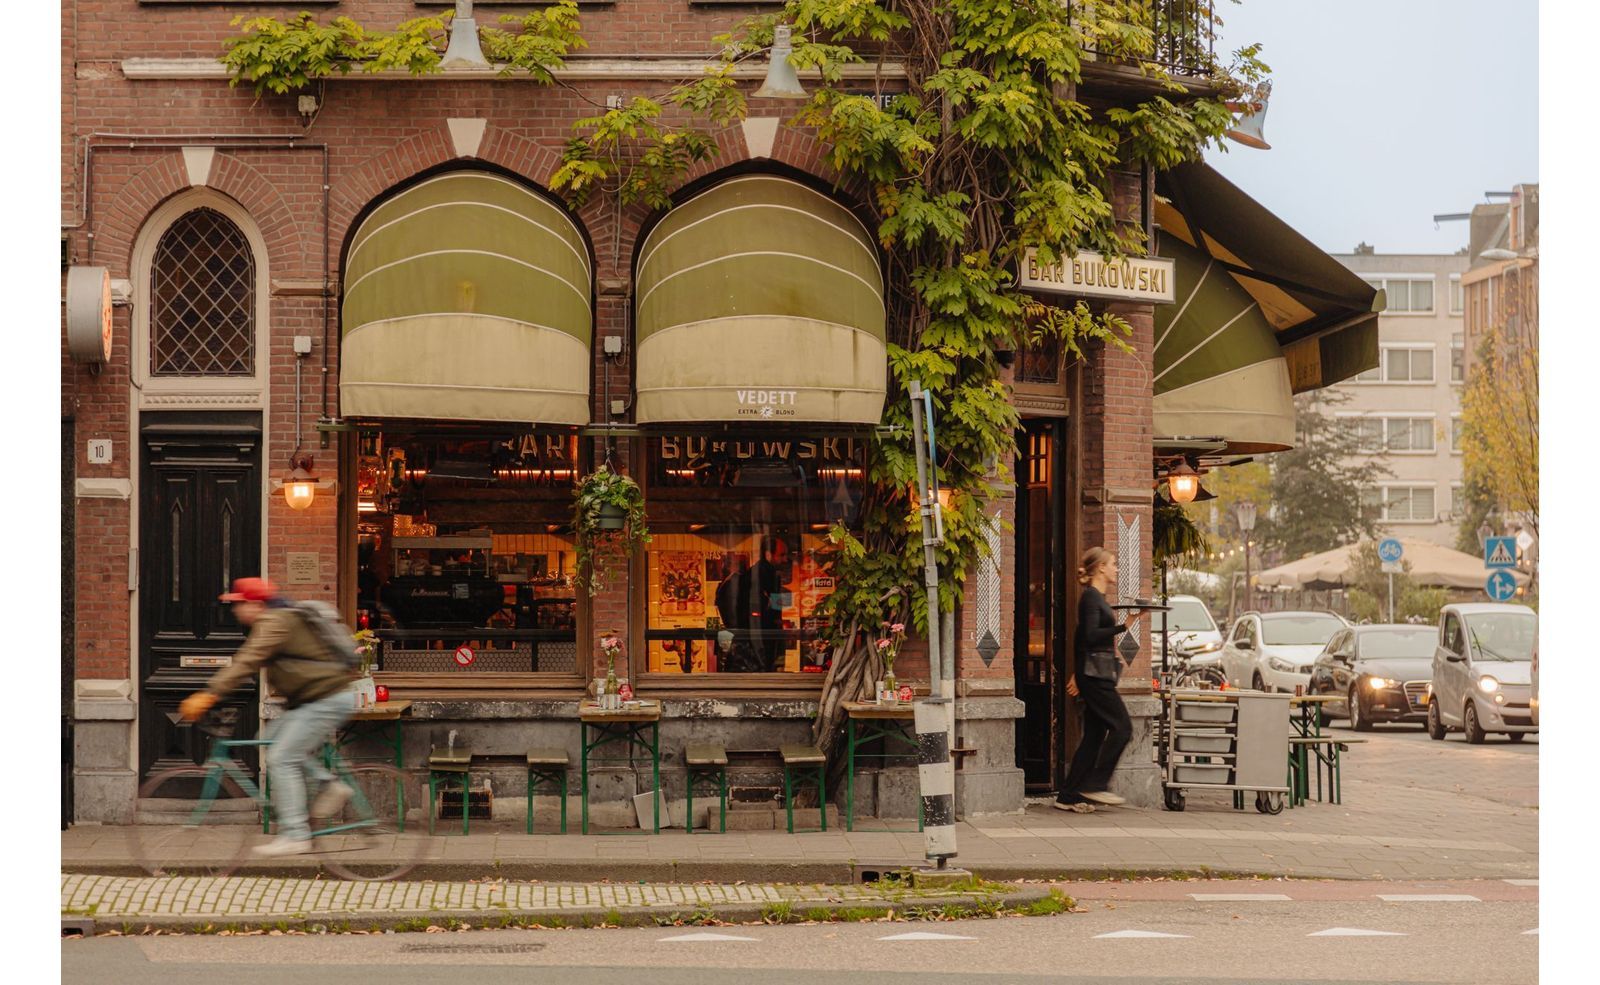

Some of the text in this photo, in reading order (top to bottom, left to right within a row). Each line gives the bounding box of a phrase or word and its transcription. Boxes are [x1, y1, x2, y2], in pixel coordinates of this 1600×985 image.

[1028, 255, 1166, 293] BAR BUKOWSKI
[737, 390, 797, 405] VEDETT
[95, 445, 104, 458] 10
